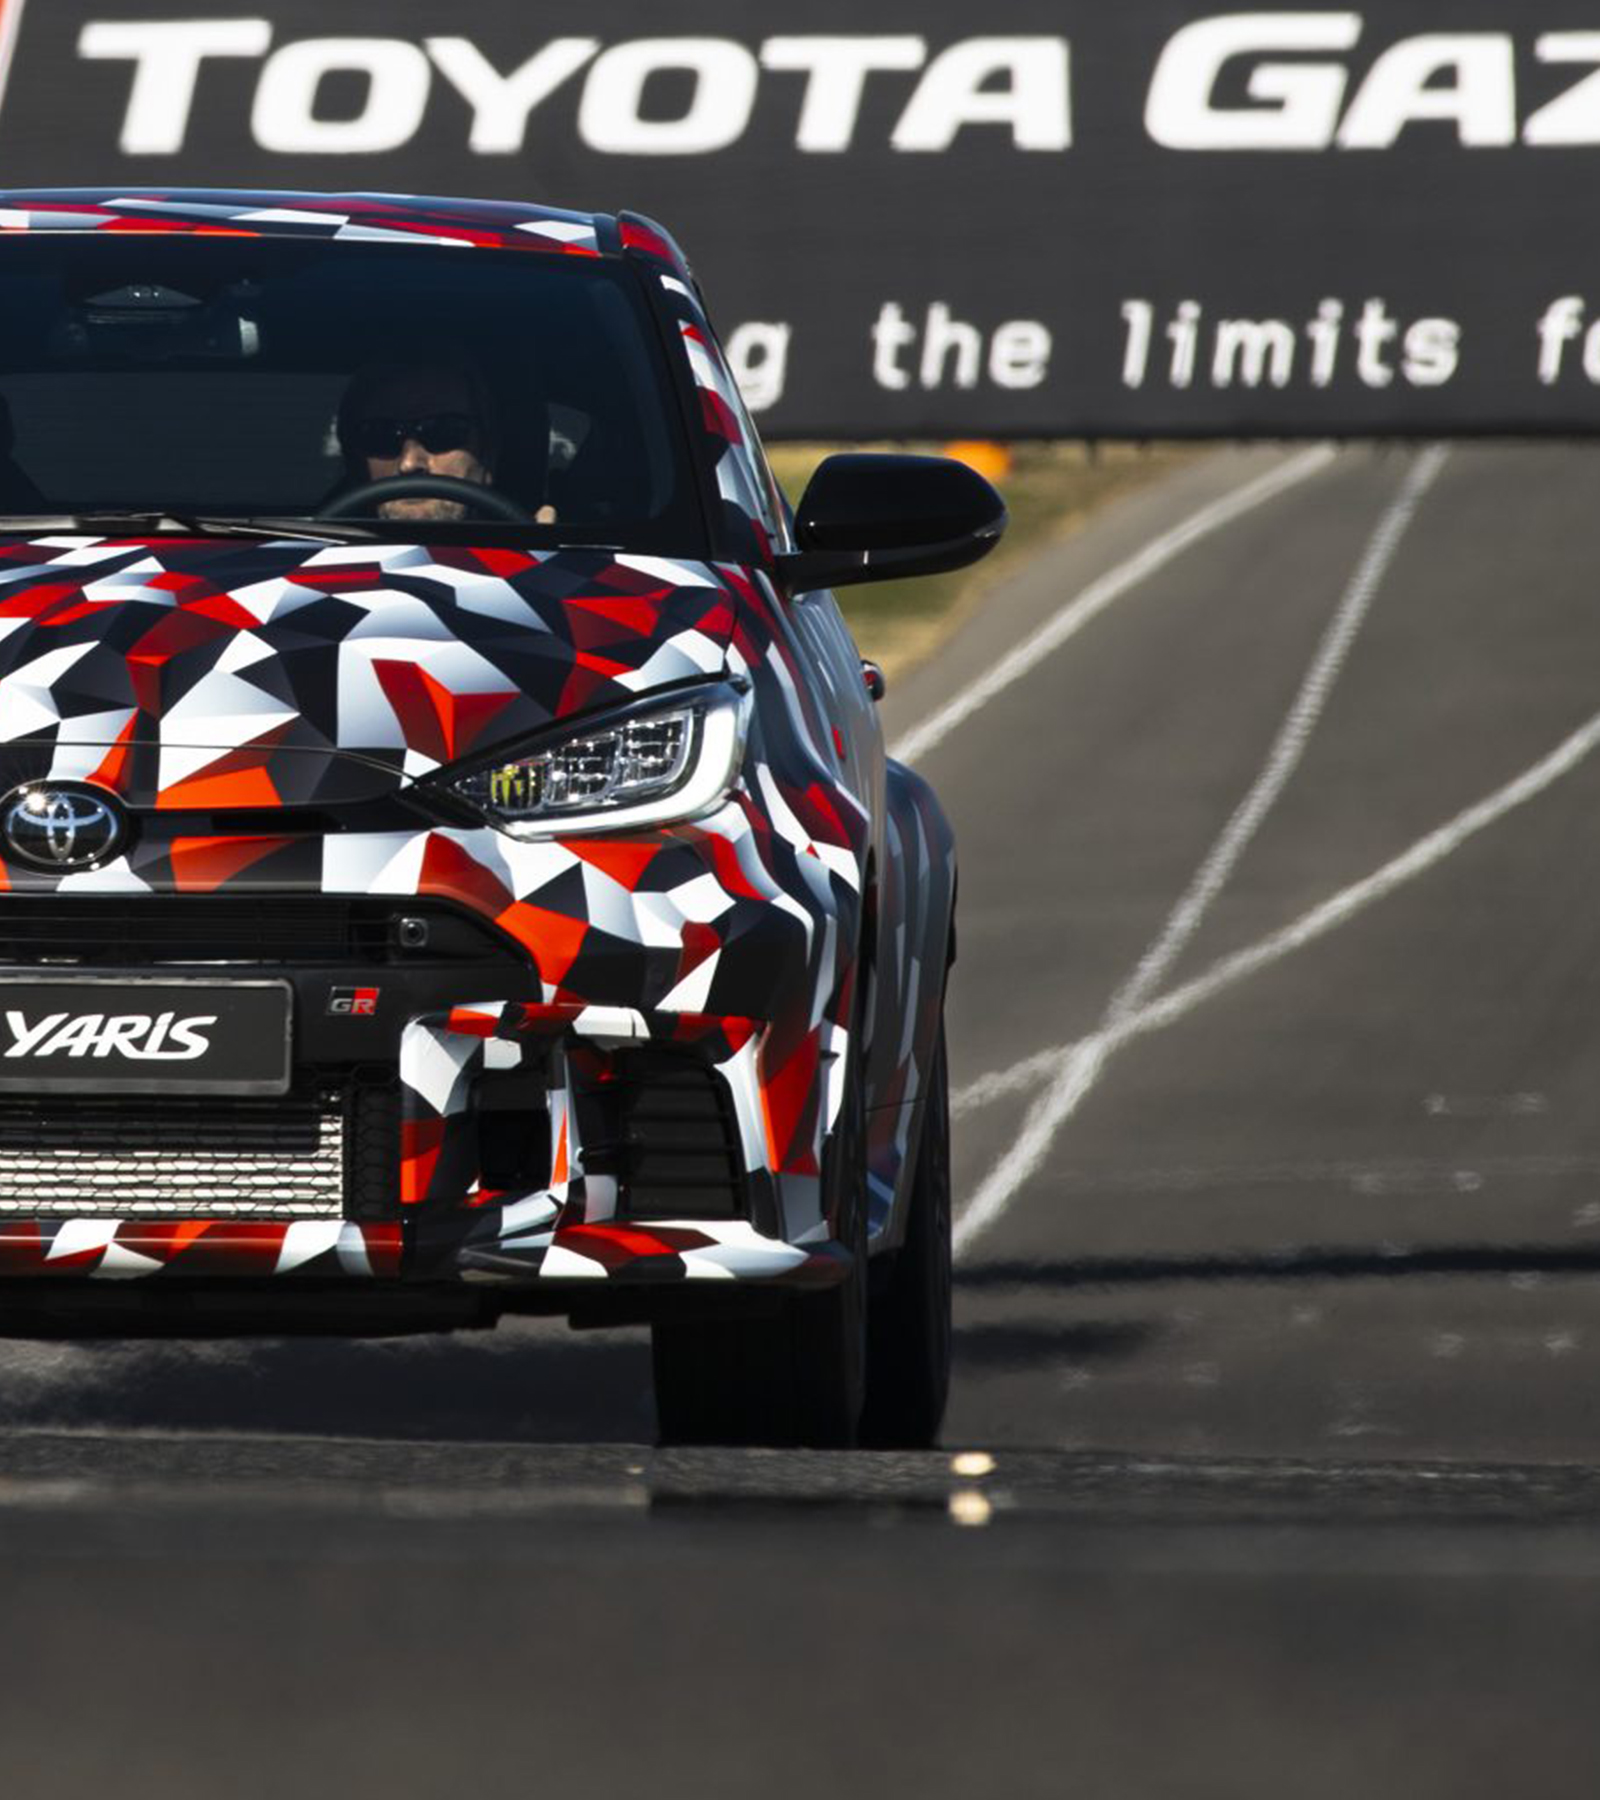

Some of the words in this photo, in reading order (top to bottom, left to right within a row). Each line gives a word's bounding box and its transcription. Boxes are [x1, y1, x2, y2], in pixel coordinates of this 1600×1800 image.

[77, 18, 1073, 155] TOYOTA
[871, 301, 1053, 391] the
[1121, 297, 1460, 389] limits
[3, 1010, 218, 1060] YARIS
